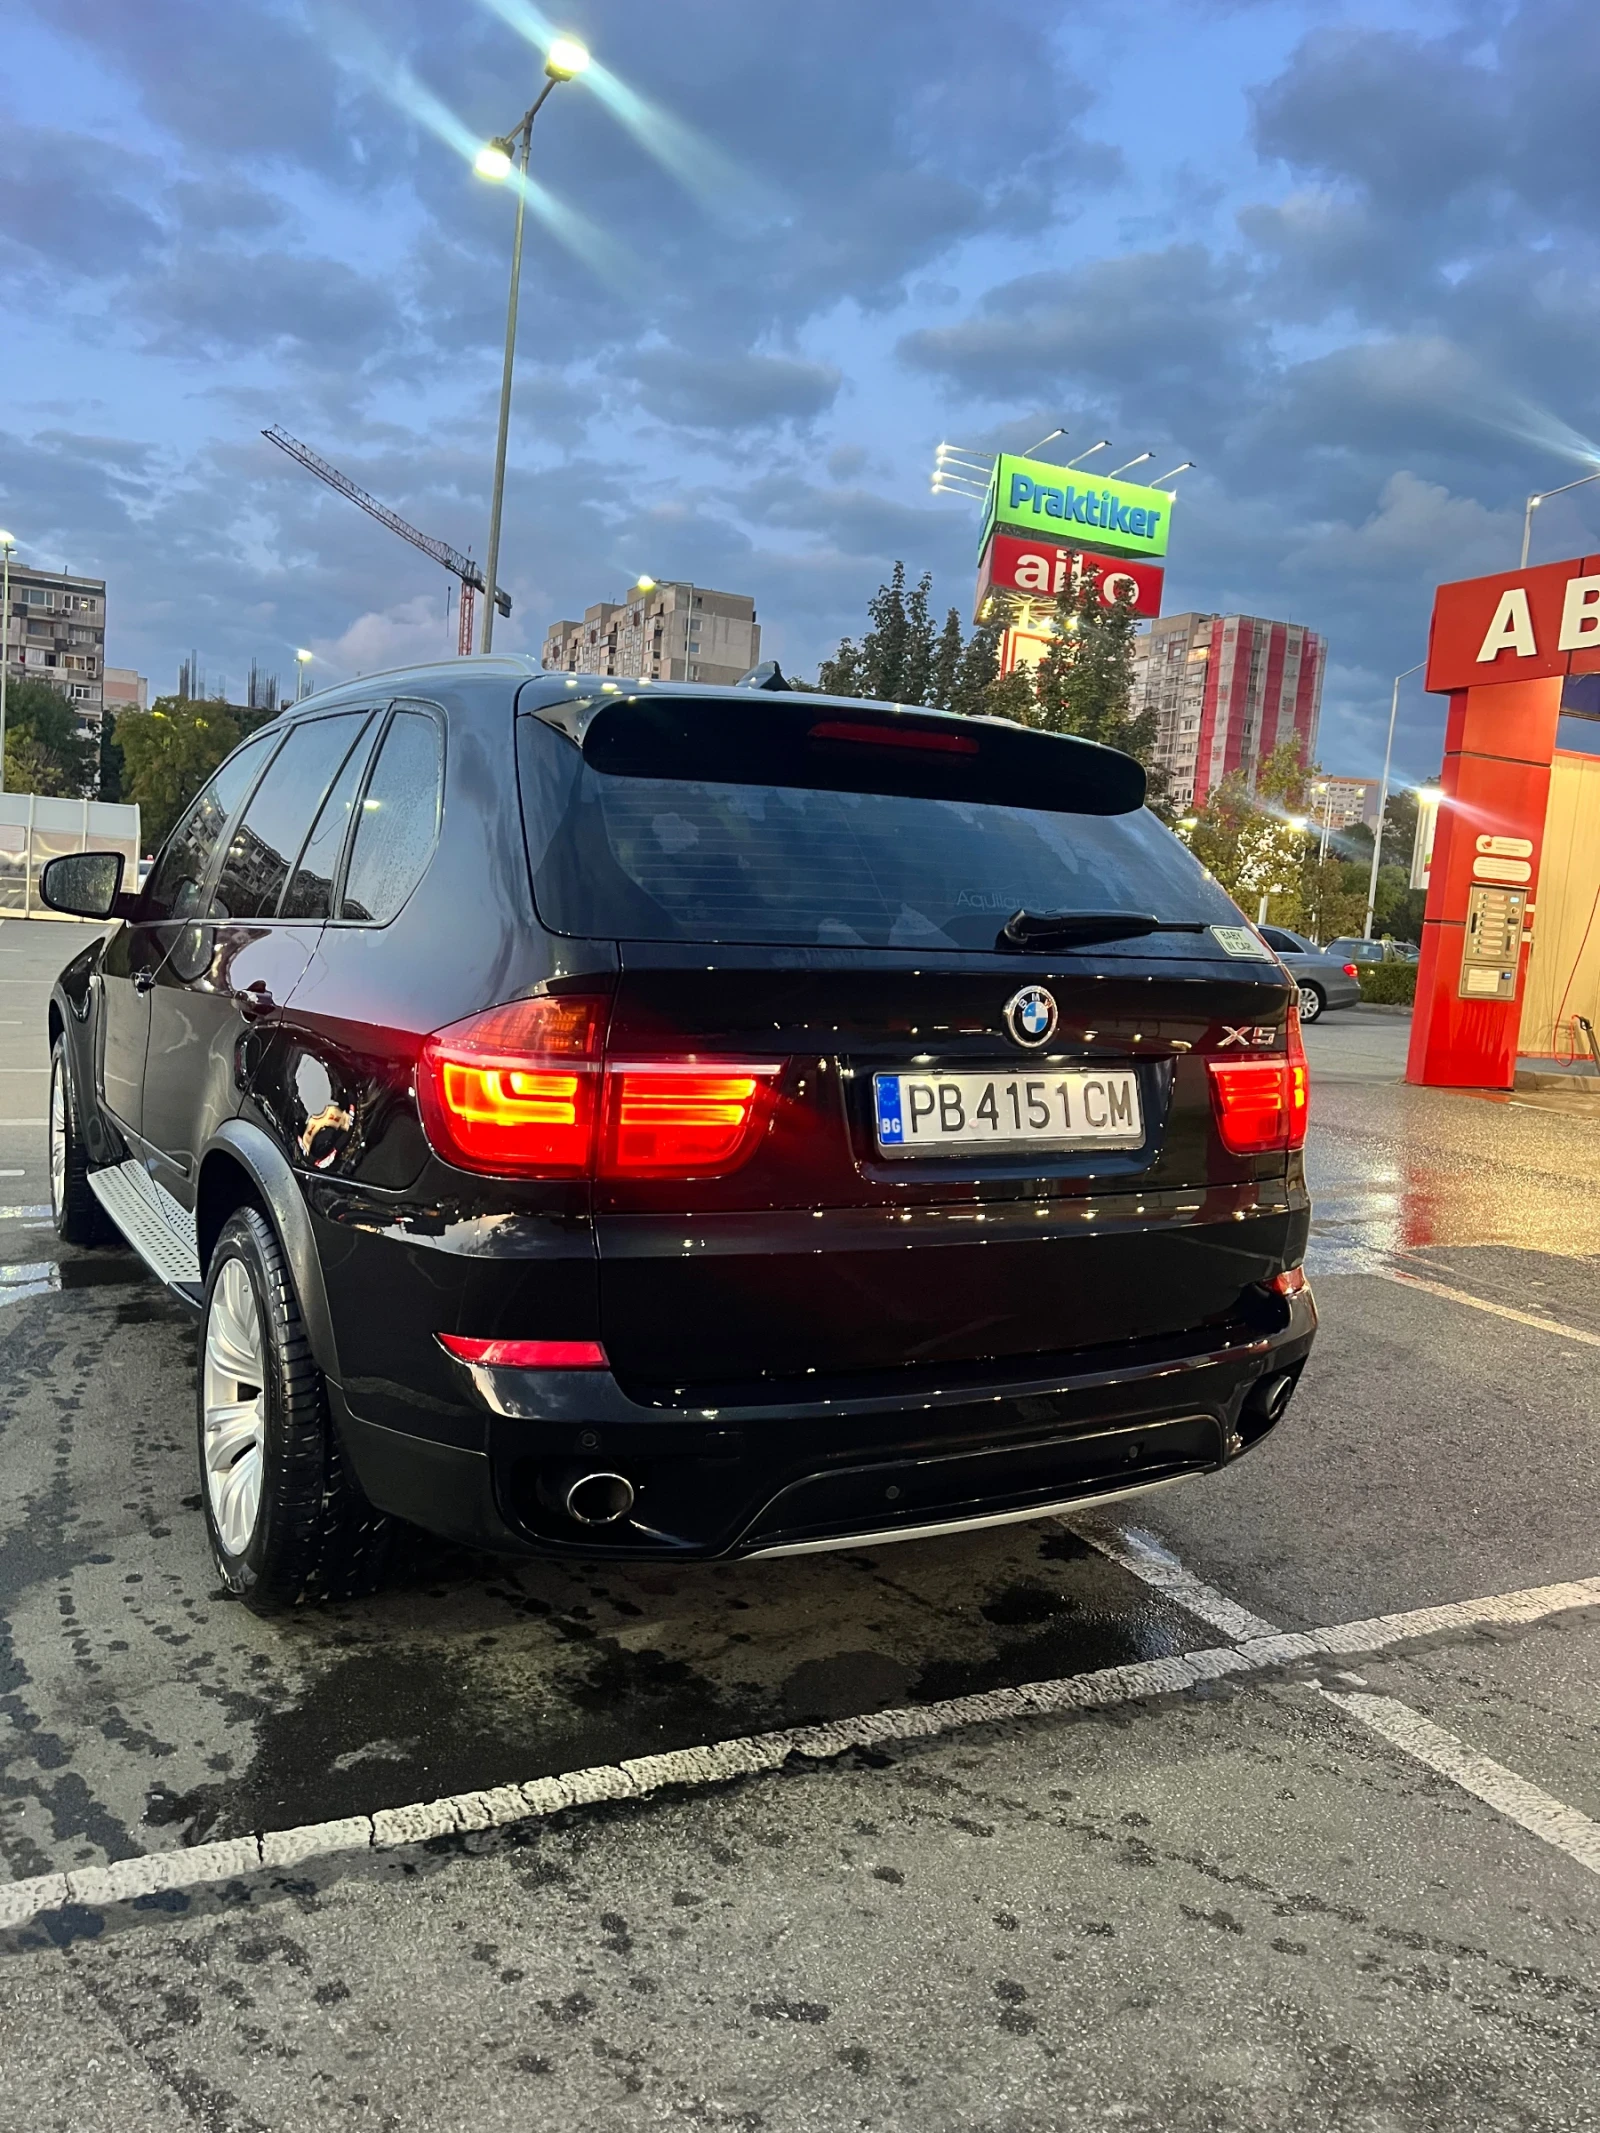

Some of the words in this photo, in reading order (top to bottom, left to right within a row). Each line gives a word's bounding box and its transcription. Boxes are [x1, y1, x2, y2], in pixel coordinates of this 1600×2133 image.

[1010, 473, 1161, 538] Praktiker
[1220, 930, 1243, 941] BABY
[1224, 940, 1237, 951] IN
[1018, 992, 1053, 1010] BMW
[1216, 1026, 1277, 1046] X5
[976, 1081, 1072, 1131] 4151
[882, 1118, 901, 1134] BG
